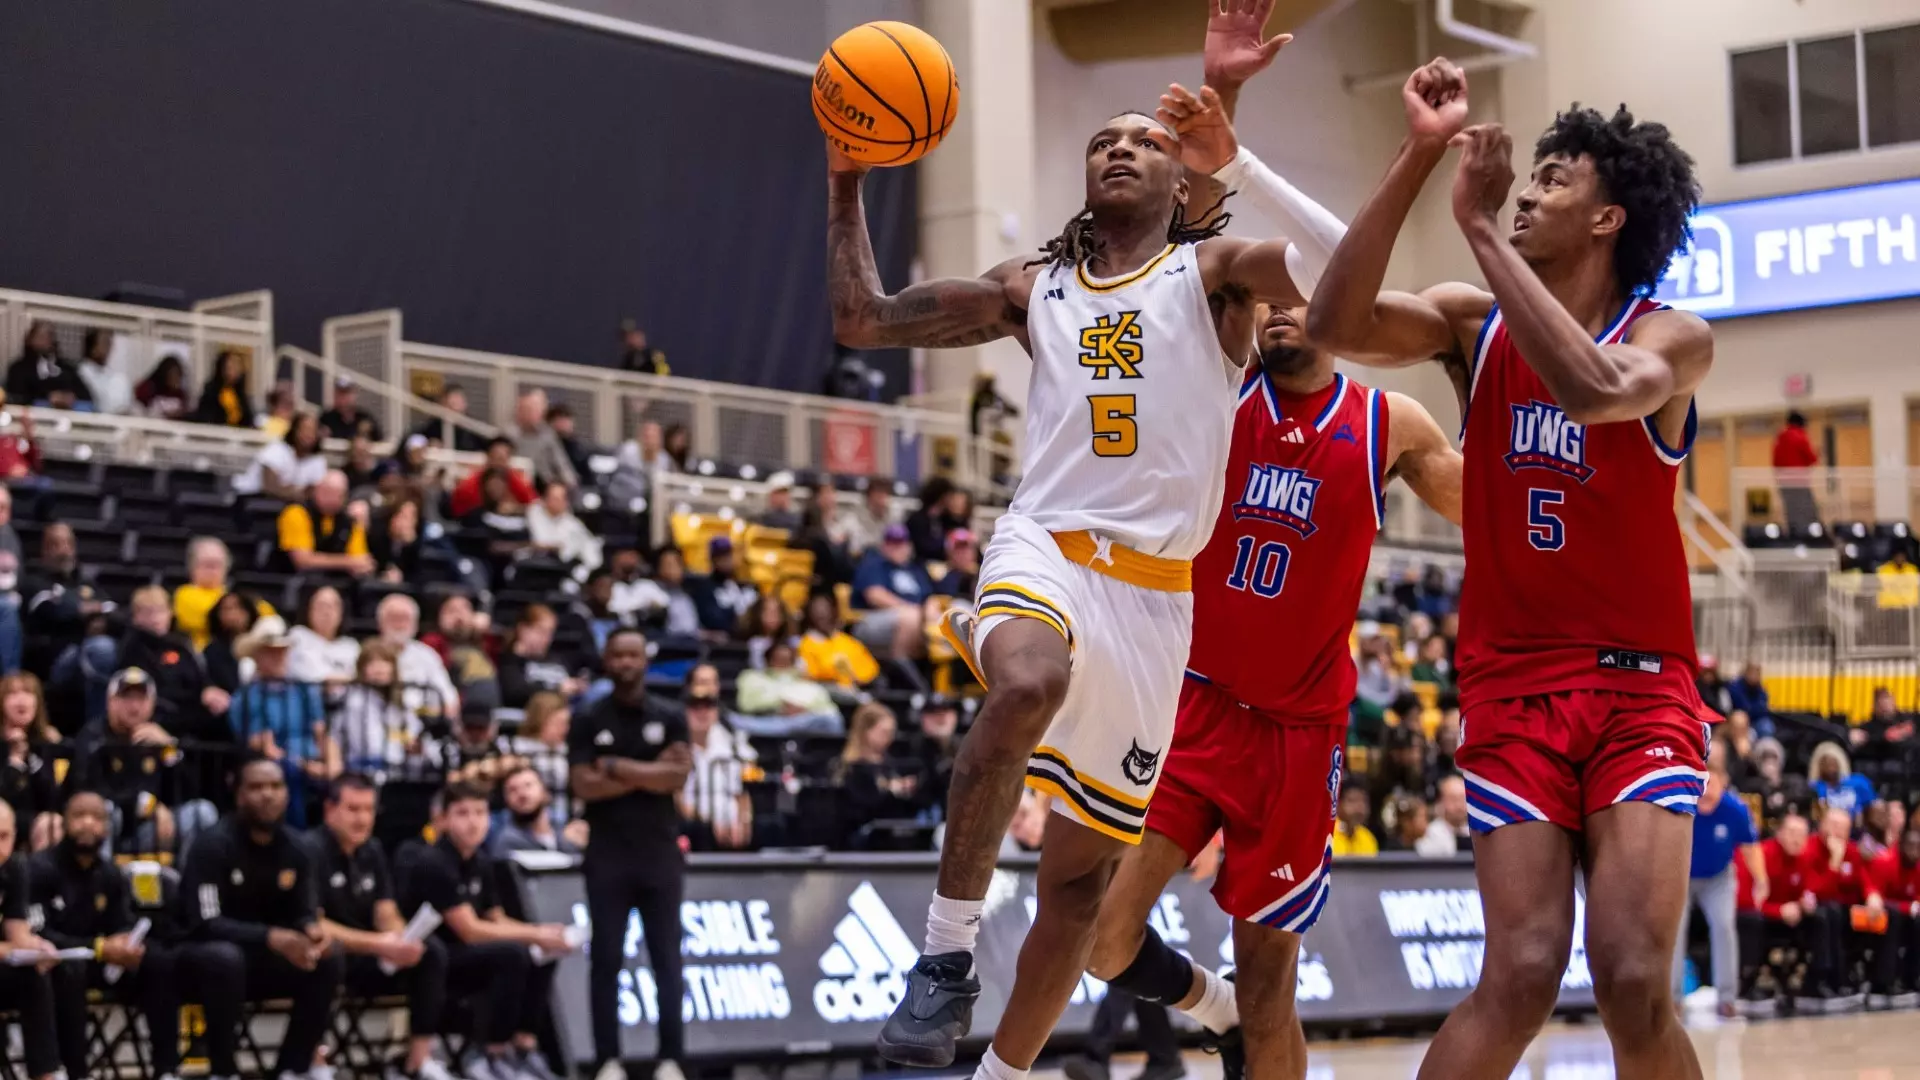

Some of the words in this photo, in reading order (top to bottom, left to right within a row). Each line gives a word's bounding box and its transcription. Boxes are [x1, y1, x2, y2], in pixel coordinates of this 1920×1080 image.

[1755, 214, 1917, 280] FIFTH
[1086, 394, 1138, 457] 5
[1513, 404, 1582, 464] UWG
[1243, 464, 1317, 521] UWG
[1528, 488, 1565, 551] 5
[1226, 535, 1291, 599] 10
[813, 967, 908, 1023] adid
